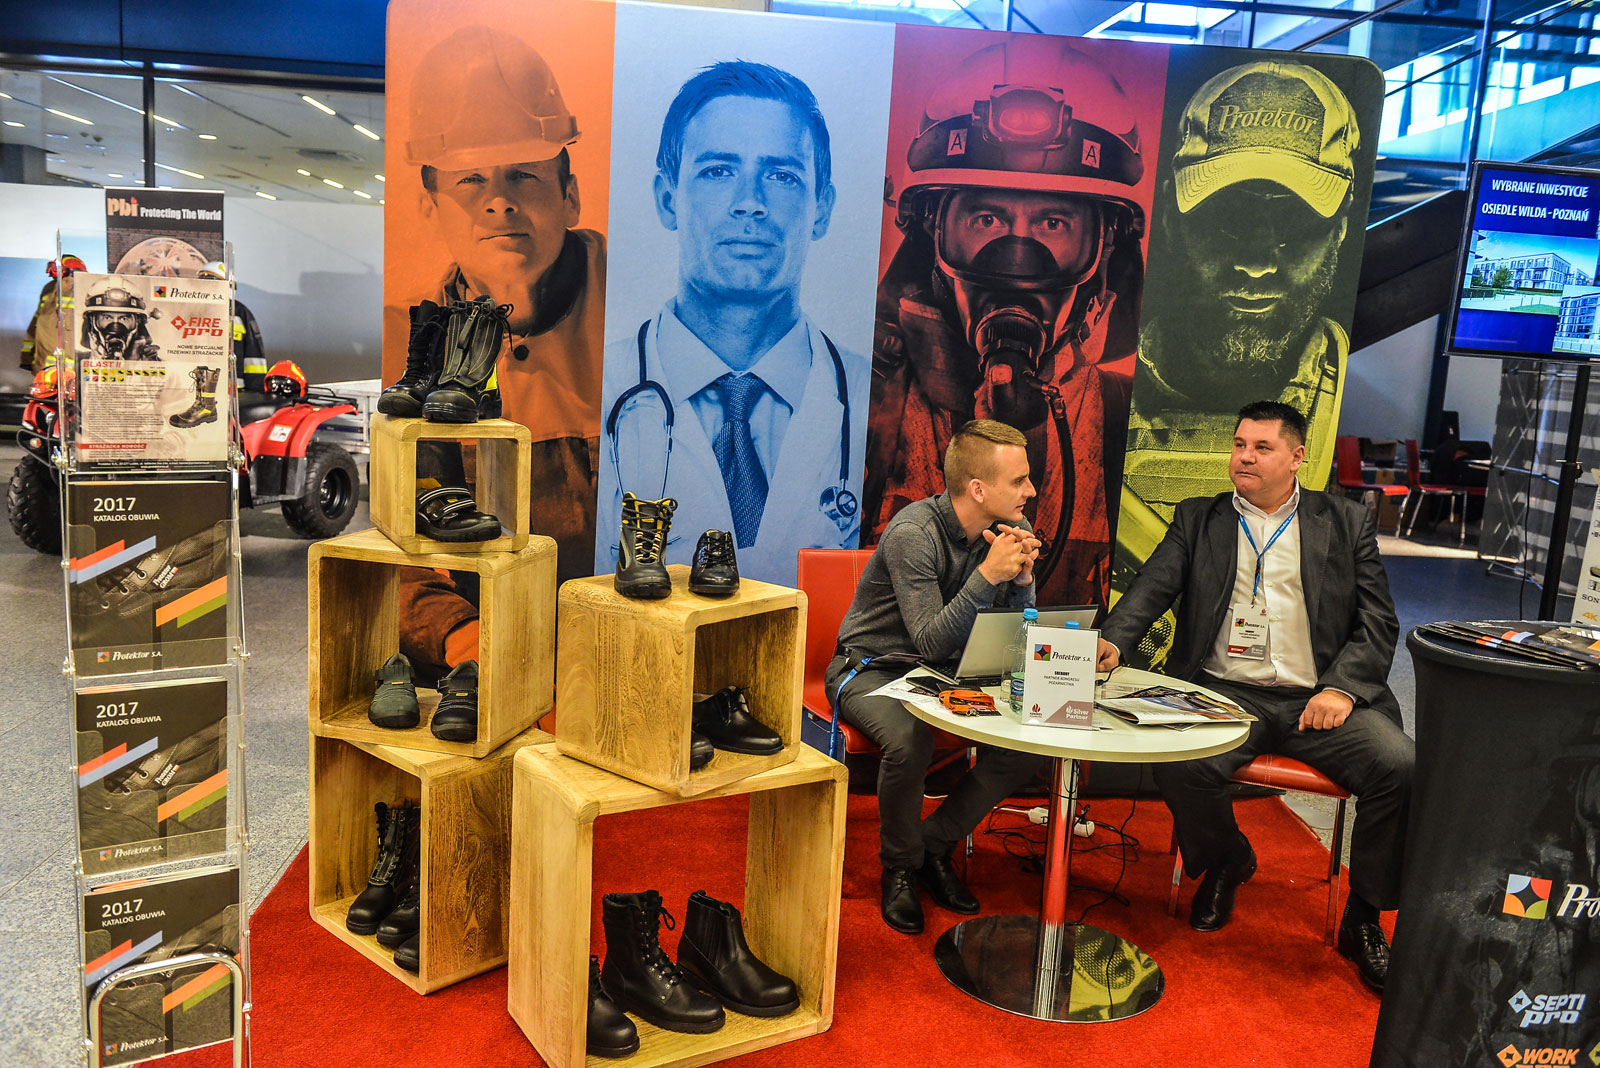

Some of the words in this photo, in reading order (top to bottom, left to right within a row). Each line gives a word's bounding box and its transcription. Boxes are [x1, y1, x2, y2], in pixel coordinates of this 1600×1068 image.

[1218, 105, 1319, 134] Protektor
[950, 133, 962, 151] A
[1085, 145, 1097, 164] A
[1492, 179, 1536, 194] WYBRANE
[1535, 182, 1589, 198] INWESTYCJE
[140, 207, 181, 220] Protecting
[181, 208, 197, 219] The
[197, 210, 222, 221] World
[1481, 203, 1518, 216] OSIEDLE
[1518, 205, 1547, 218] WILDA
[1552, 208, 1589, 222] POZNAŃ
[170, 287, 210, 300] Protektor
[188, 317, 221, 328] FIRE
[182, 327, 223, 339] pro
[93, 497, 136, 512] 2017
[93, 514, 127, 522] KATALOG
[128, 513, 160, 521] OBUWIA
[1582, 611, 1598, 622] 4K
[112, 651, 149, 661] Protektor
[1052, 651, 1081, 661] Protektor
[96, 702, 139, 719] 2017
[96, 718, 129, 728] KATALOG
[130, 715, 162, 725] OBUWIA
[114, 847, 152, 858] Protektor
[101, 898, 143, 918] 2017
[1556, 883, 1600, 918] Pro
[101, 915, 135, 927] KATALOG
[135, 910, 166, 922] OBUWIA
[1531, 993, 1587, 1011] SEPTI
[1519, 1009, 1581, 1028] pro
[120, 1038, 157, 1052] Protektor
[1522, 1047, 1580, 1065] WORK
